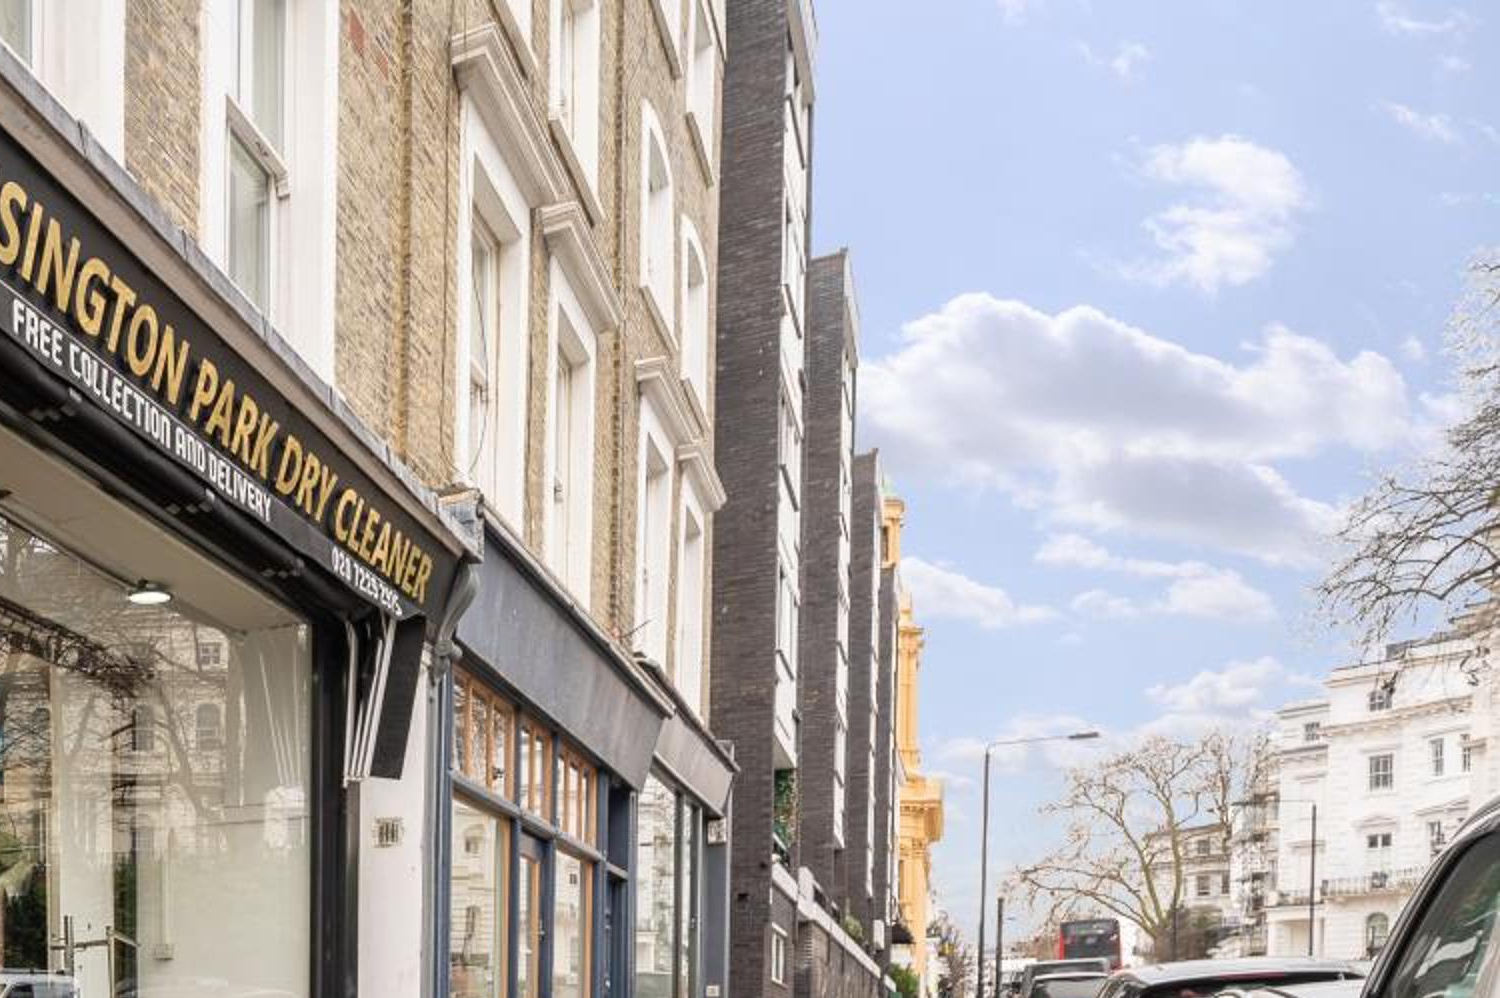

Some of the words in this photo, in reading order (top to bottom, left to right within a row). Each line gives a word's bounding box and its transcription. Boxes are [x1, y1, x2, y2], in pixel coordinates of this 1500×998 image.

[12, 298, 63, 366] FREE
[69, 342, 171, 450] COLLECTION
[175, 427, 206, 473] AND
[208, 456, 271, 522] DELIVERY
[190, 357, 279, 481] PARK
[275, 435, 338, 523] DRY
[335, 489, 433, 604] CLEANER
